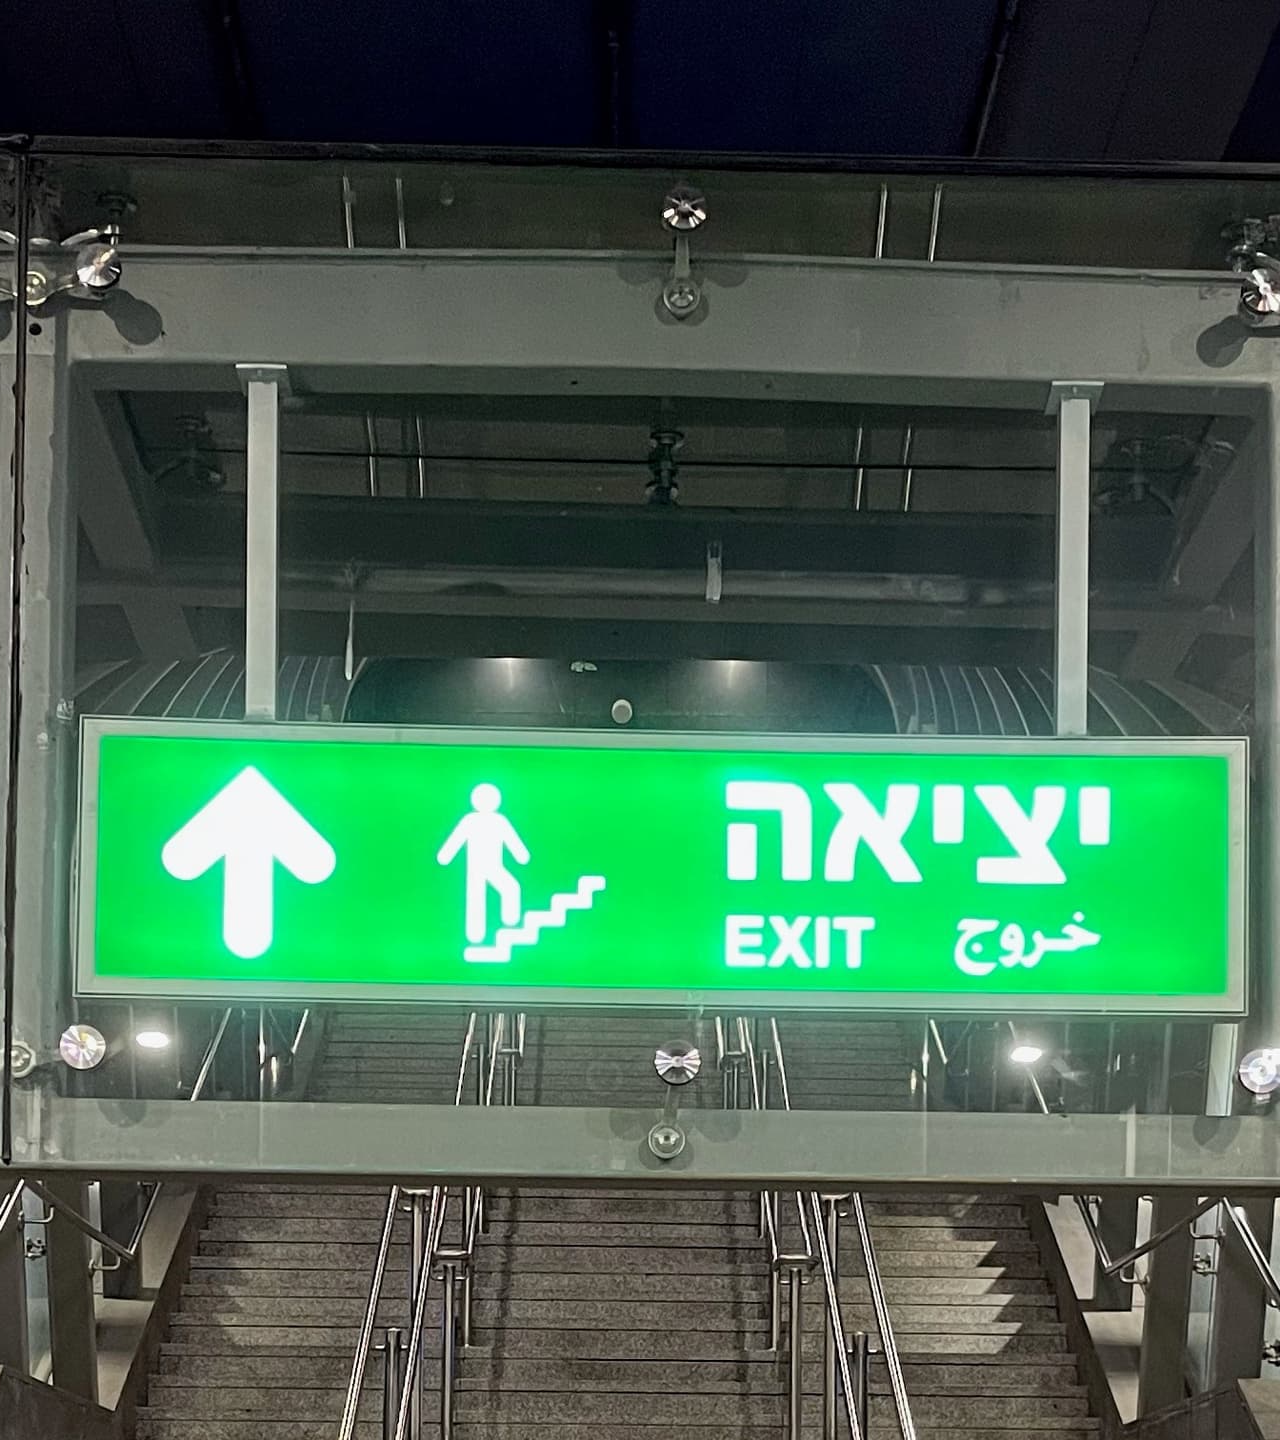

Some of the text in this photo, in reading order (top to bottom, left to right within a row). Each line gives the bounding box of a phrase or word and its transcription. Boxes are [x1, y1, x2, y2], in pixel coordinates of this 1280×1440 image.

[725, 781, 1111, 884] יציאה
[725, 914, 876, 968] EXIT
[953, 910, 1102, 977] خروج
